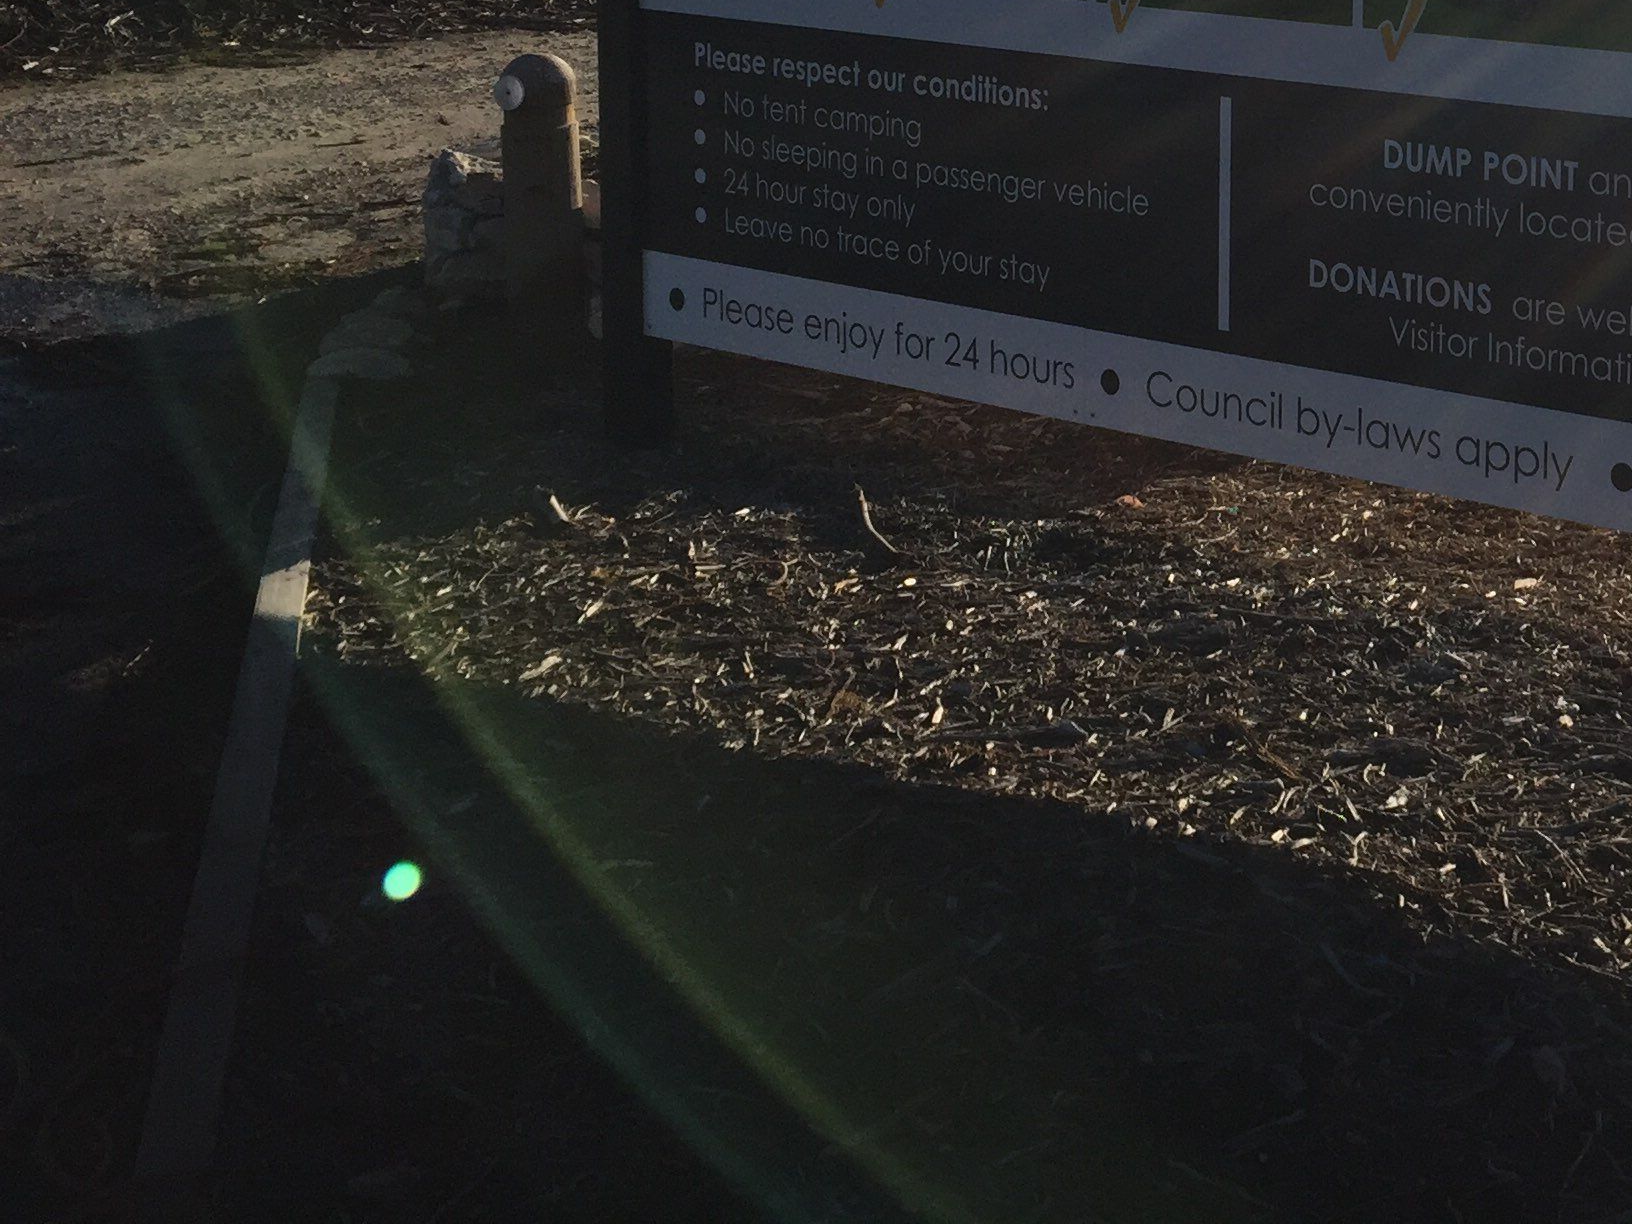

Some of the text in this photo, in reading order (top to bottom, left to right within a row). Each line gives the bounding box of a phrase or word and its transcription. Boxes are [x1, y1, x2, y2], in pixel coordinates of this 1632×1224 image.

[694, 42, 1049, 112] Please respect our conditions:
[724, 90, 922, 147] No tent camping
[724, 130, 1149, 216] No sleeping in a passenger vehicle
[1383, 139, 1472, 178] DUMP
[1483, 151, 1579, 191] POINT
[724, 168, 916, 227] 24 hour stay only
[1309, 182, 1509, 238] conveniently
[724, 208, 1050, 292] Leave no trace of your stay
[1309, 258, 1492, 314] DONATIONS
[1513, 295, 1565, 325] are
[1388, 315, 1478, 359] Visitor
[703, 288, 794, 334] Please
[804, 312, 885, 359] enjoy
[896, 322, 935, 361] for
[944, 332, 979, 370] 24
[990, 341, 1075, 389] hours
[1146, 370, 1284, 430] Council
[1297, 396, 1441, 460] by-laws
[1455, 434, 1574, 490] apply
